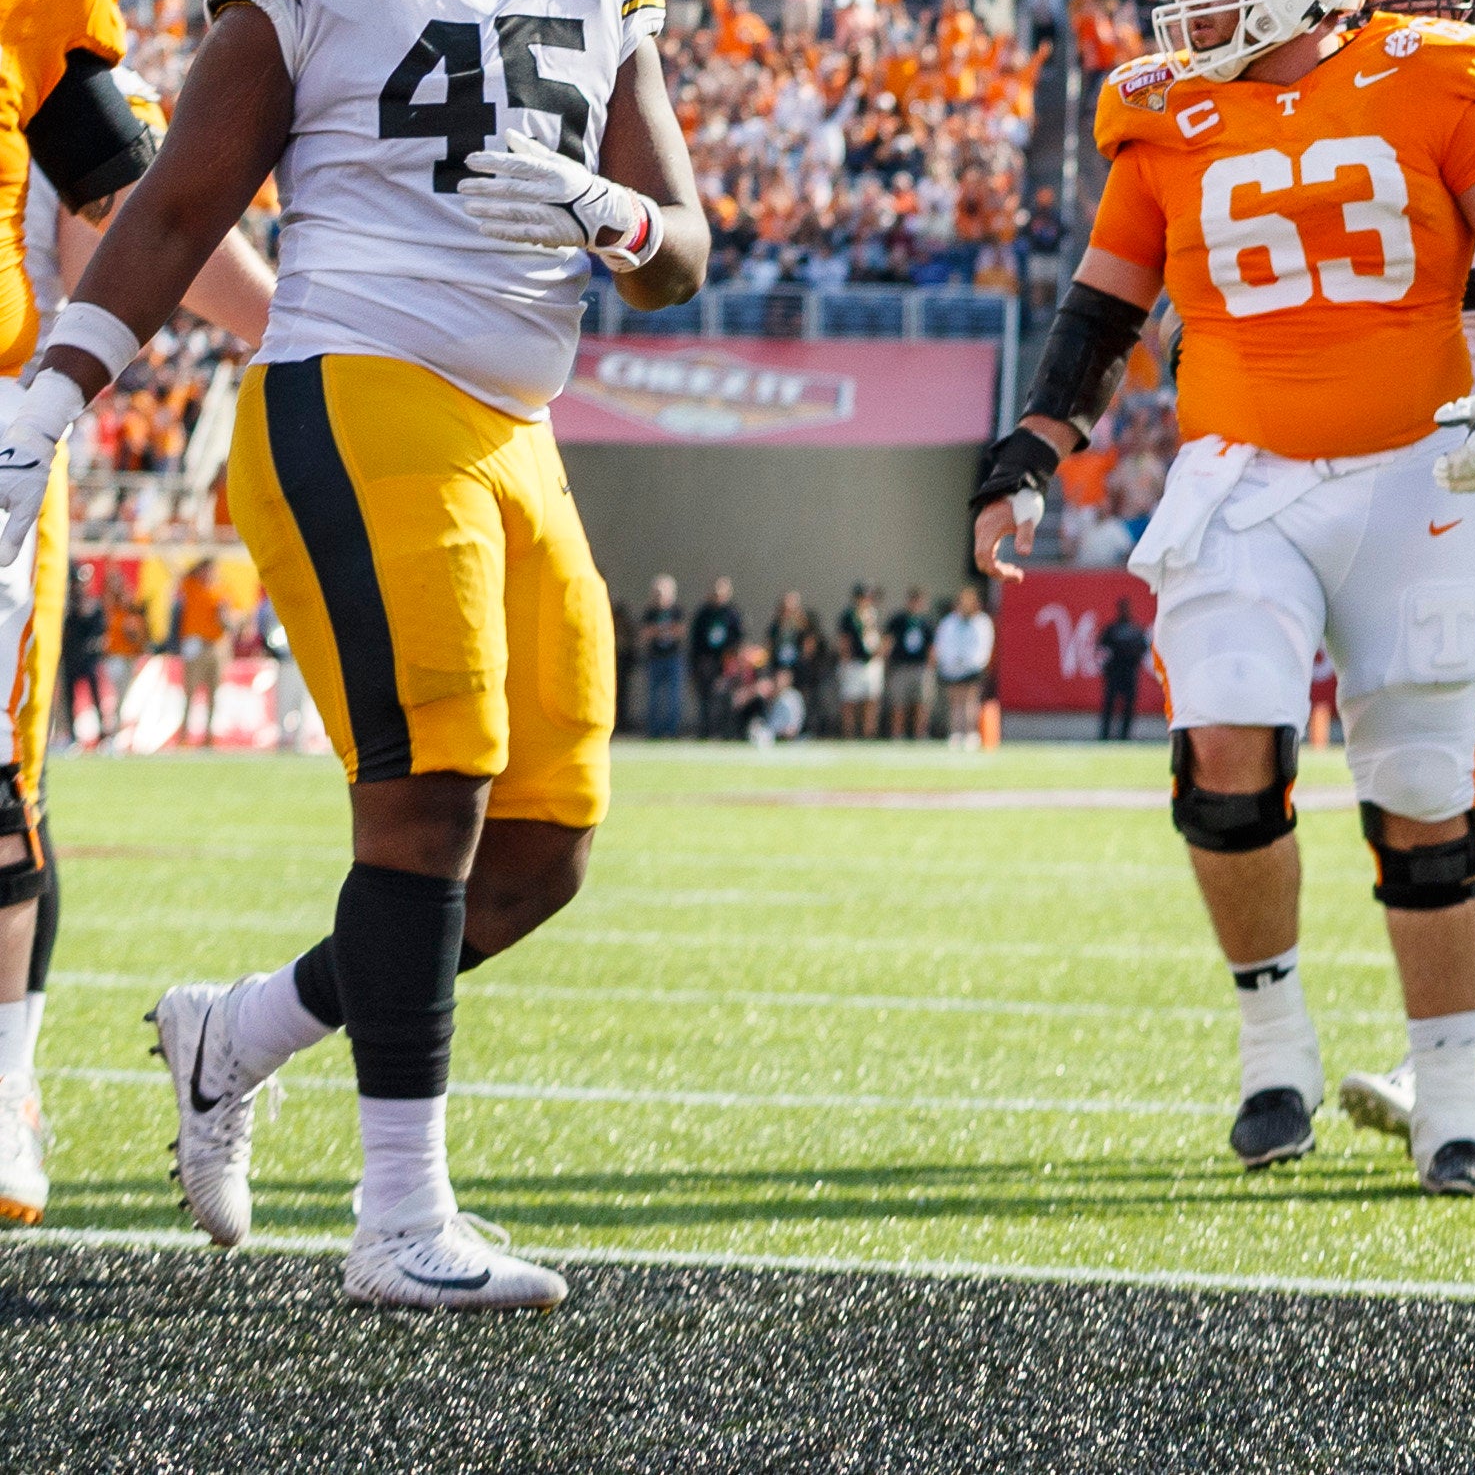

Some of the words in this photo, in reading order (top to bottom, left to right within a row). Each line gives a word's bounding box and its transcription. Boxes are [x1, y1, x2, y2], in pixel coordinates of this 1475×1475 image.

[1383, 27, 1422, 58] SEC
[378, 13, 591, 194] 45
[1175, 99, 1220, 139] C
[1275, 90, 1301, 117] T
[1199, 135, 1415, 318] 63
